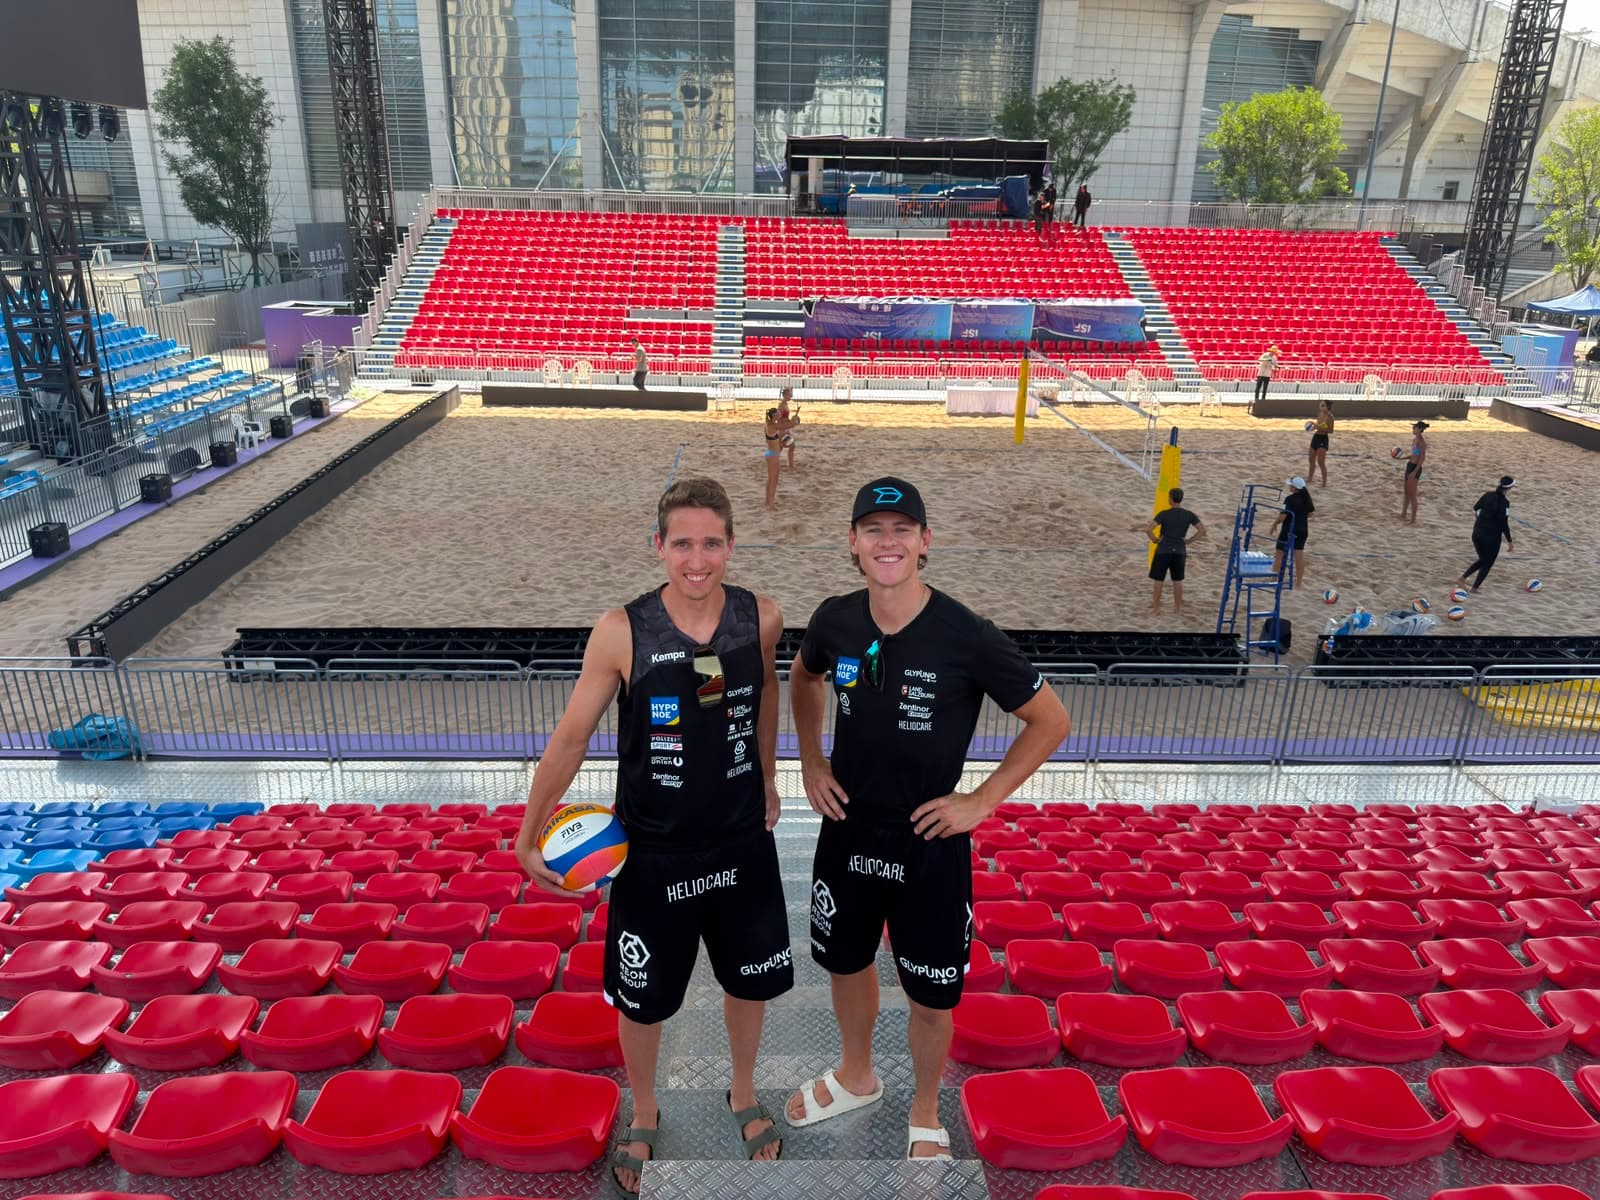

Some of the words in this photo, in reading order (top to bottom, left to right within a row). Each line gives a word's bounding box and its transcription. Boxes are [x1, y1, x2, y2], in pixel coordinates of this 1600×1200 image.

[961, 328, 979, 338] ISF
[651, 651, 686, 664] Kempa
[837, 662, 858, 673] HYPO
[836, 671, 852, 680] NOE
[651, 703, 678, 711] HYPO
[899, 702, 930, 712] Zentinor
[652, 711, 672, 719] NOE
[898, 719, 933, 731] HELIOCARE
[543, 805, 596, 840] MIKASA
[847, 855, 905, 883] HELIOCARE
[666, 868, 738, 903] HELIOCARE
[899, 957, 958, 979] GLYPUNO
